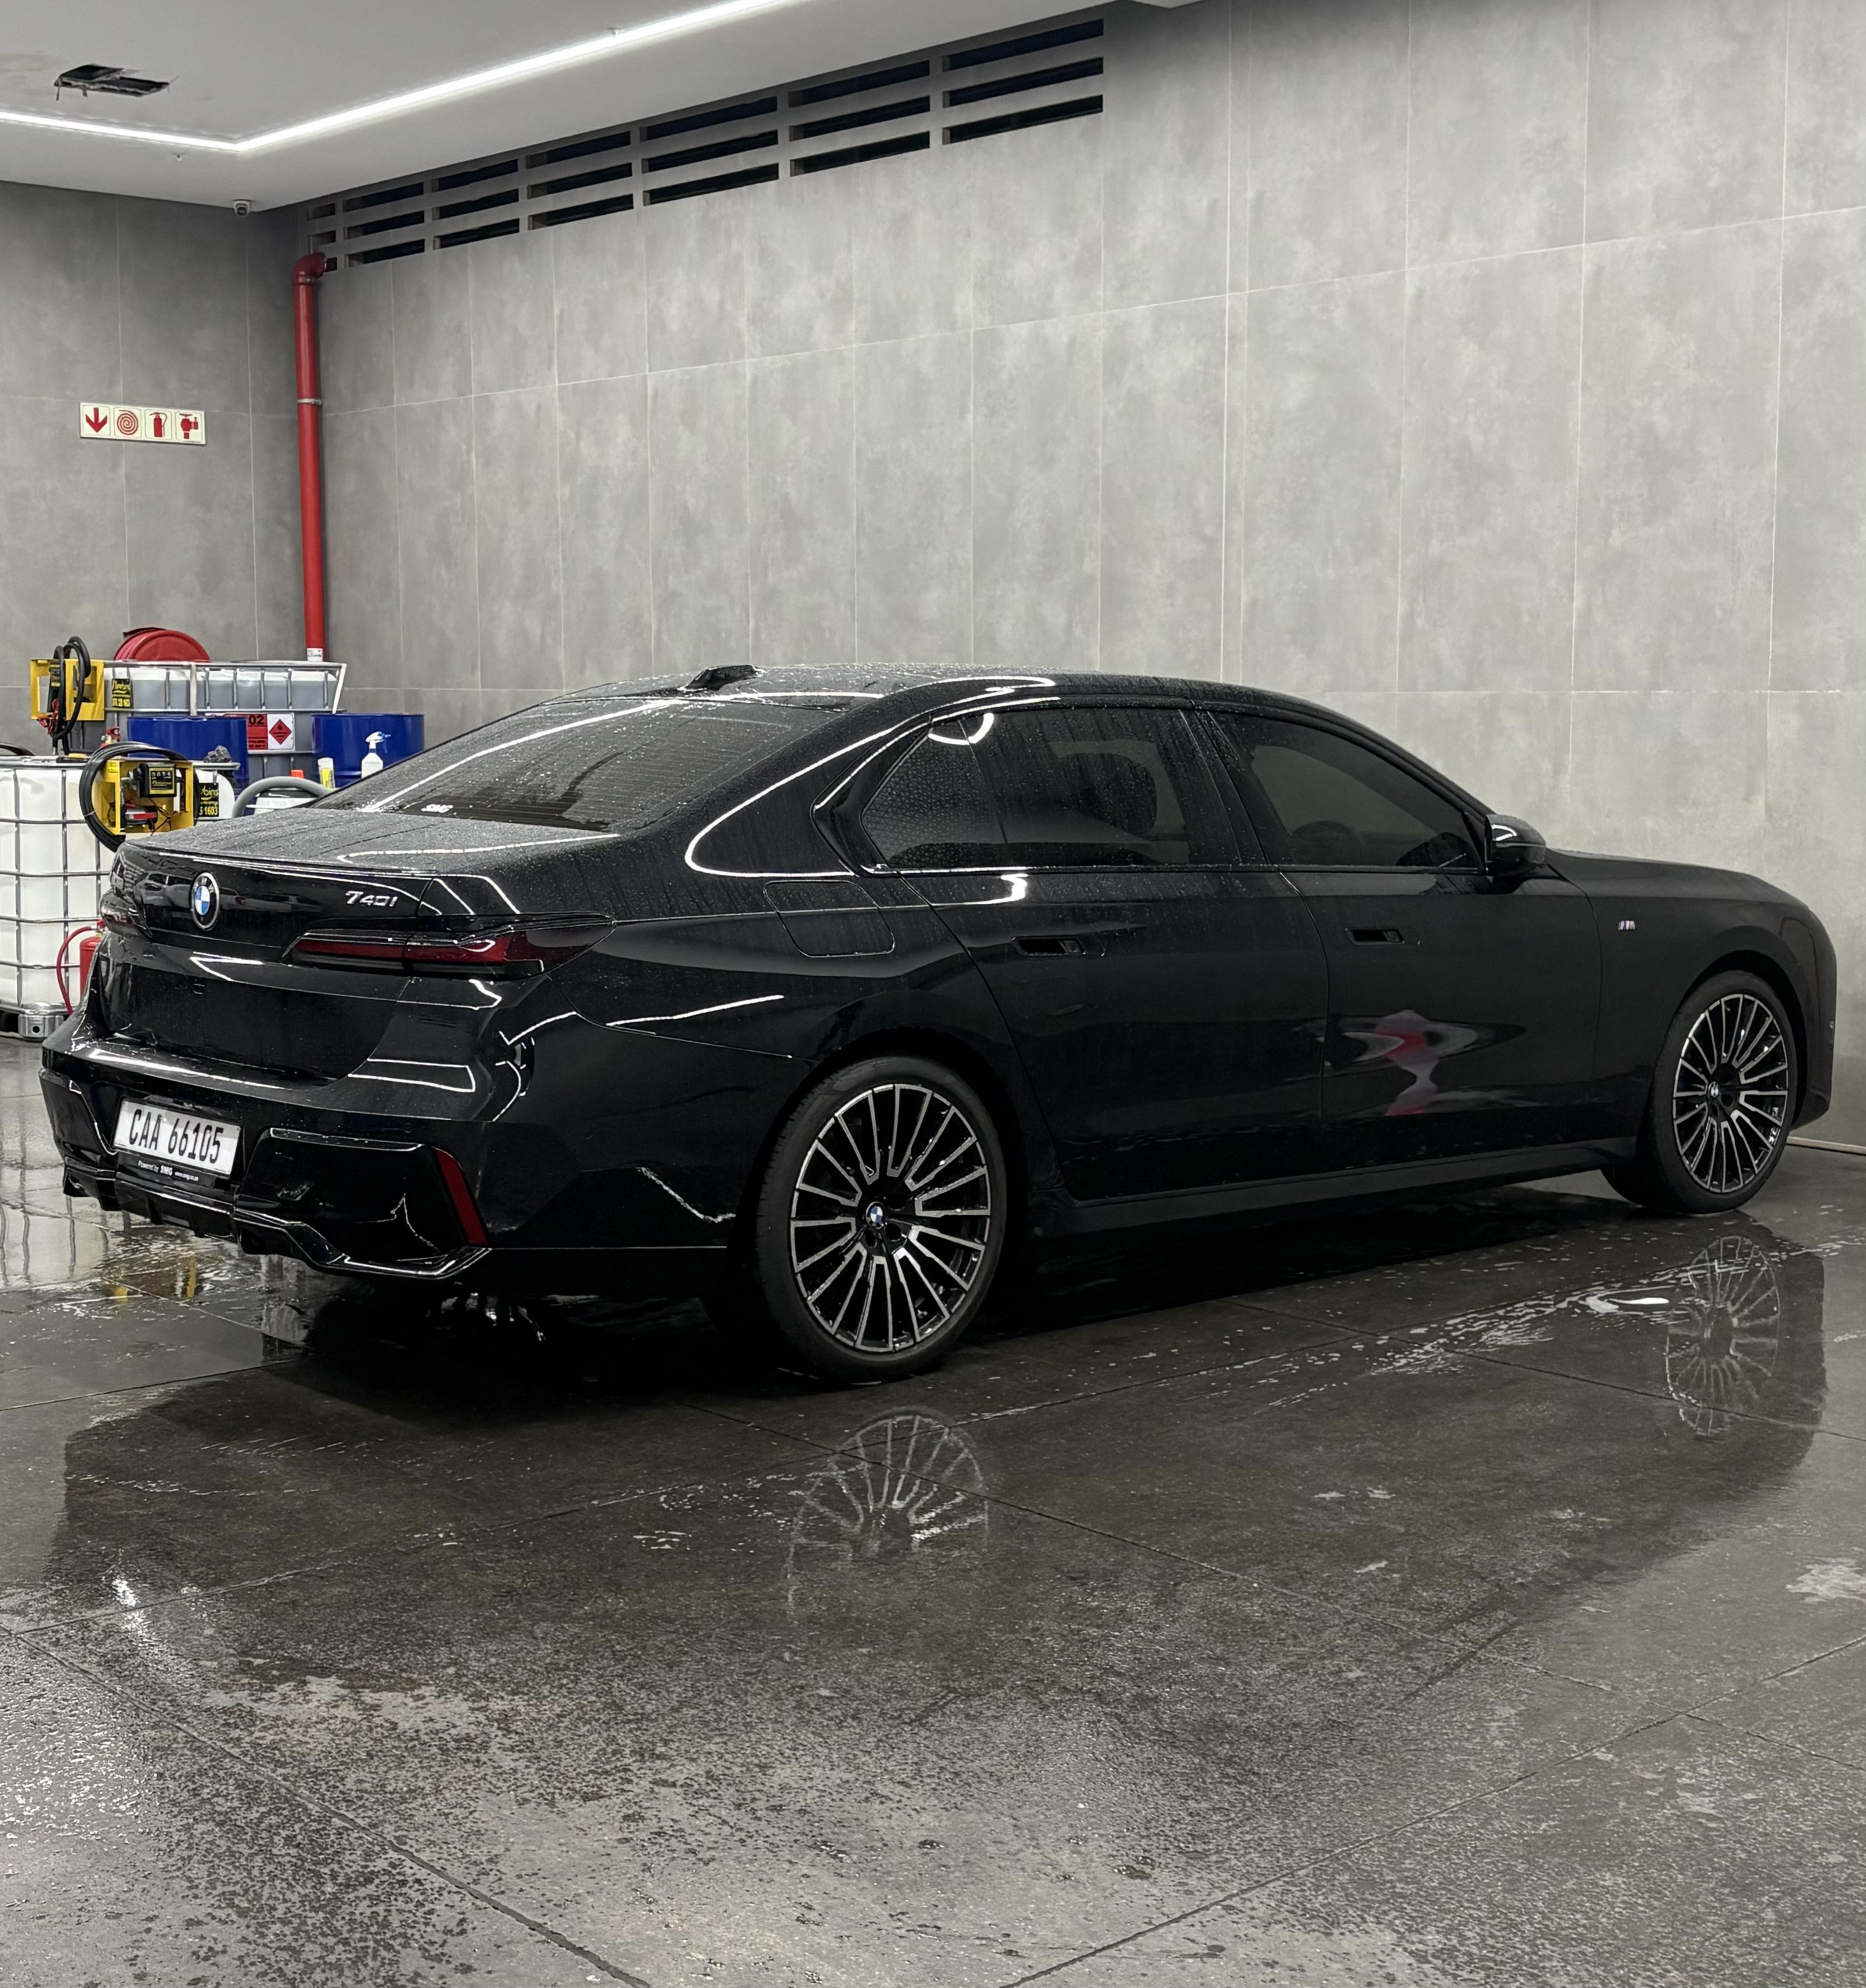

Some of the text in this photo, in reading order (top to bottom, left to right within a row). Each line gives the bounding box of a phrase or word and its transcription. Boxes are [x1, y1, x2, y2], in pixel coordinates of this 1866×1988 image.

[129, 1109, 224, 1164] CAA 66105
[160, 1165, 173, 1176] SMG
